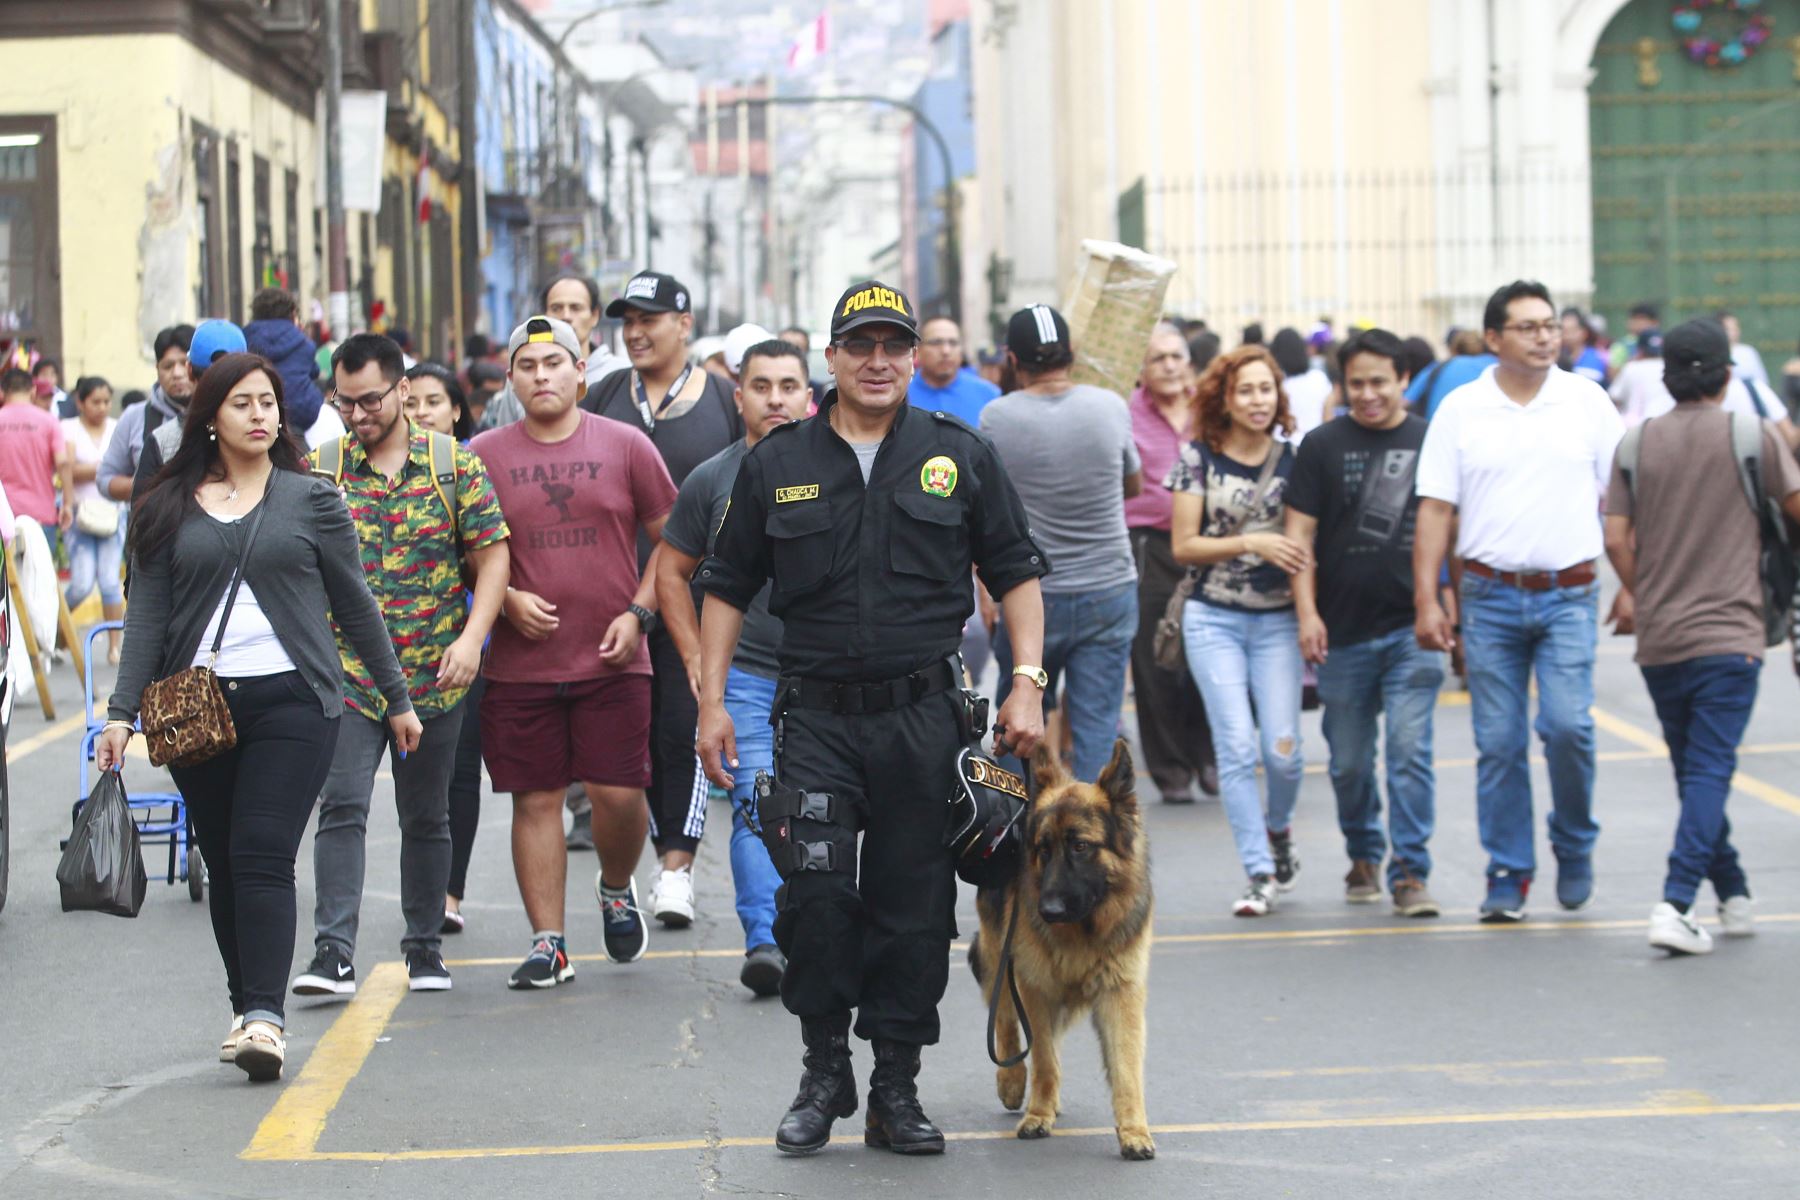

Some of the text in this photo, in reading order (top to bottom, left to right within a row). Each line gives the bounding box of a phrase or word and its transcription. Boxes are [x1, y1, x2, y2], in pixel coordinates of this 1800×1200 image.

[842, 286, 909, 317] POLICIA
[510, 462, 602, 487] HAPPY
[528, 527, 598, 549] HOUR
